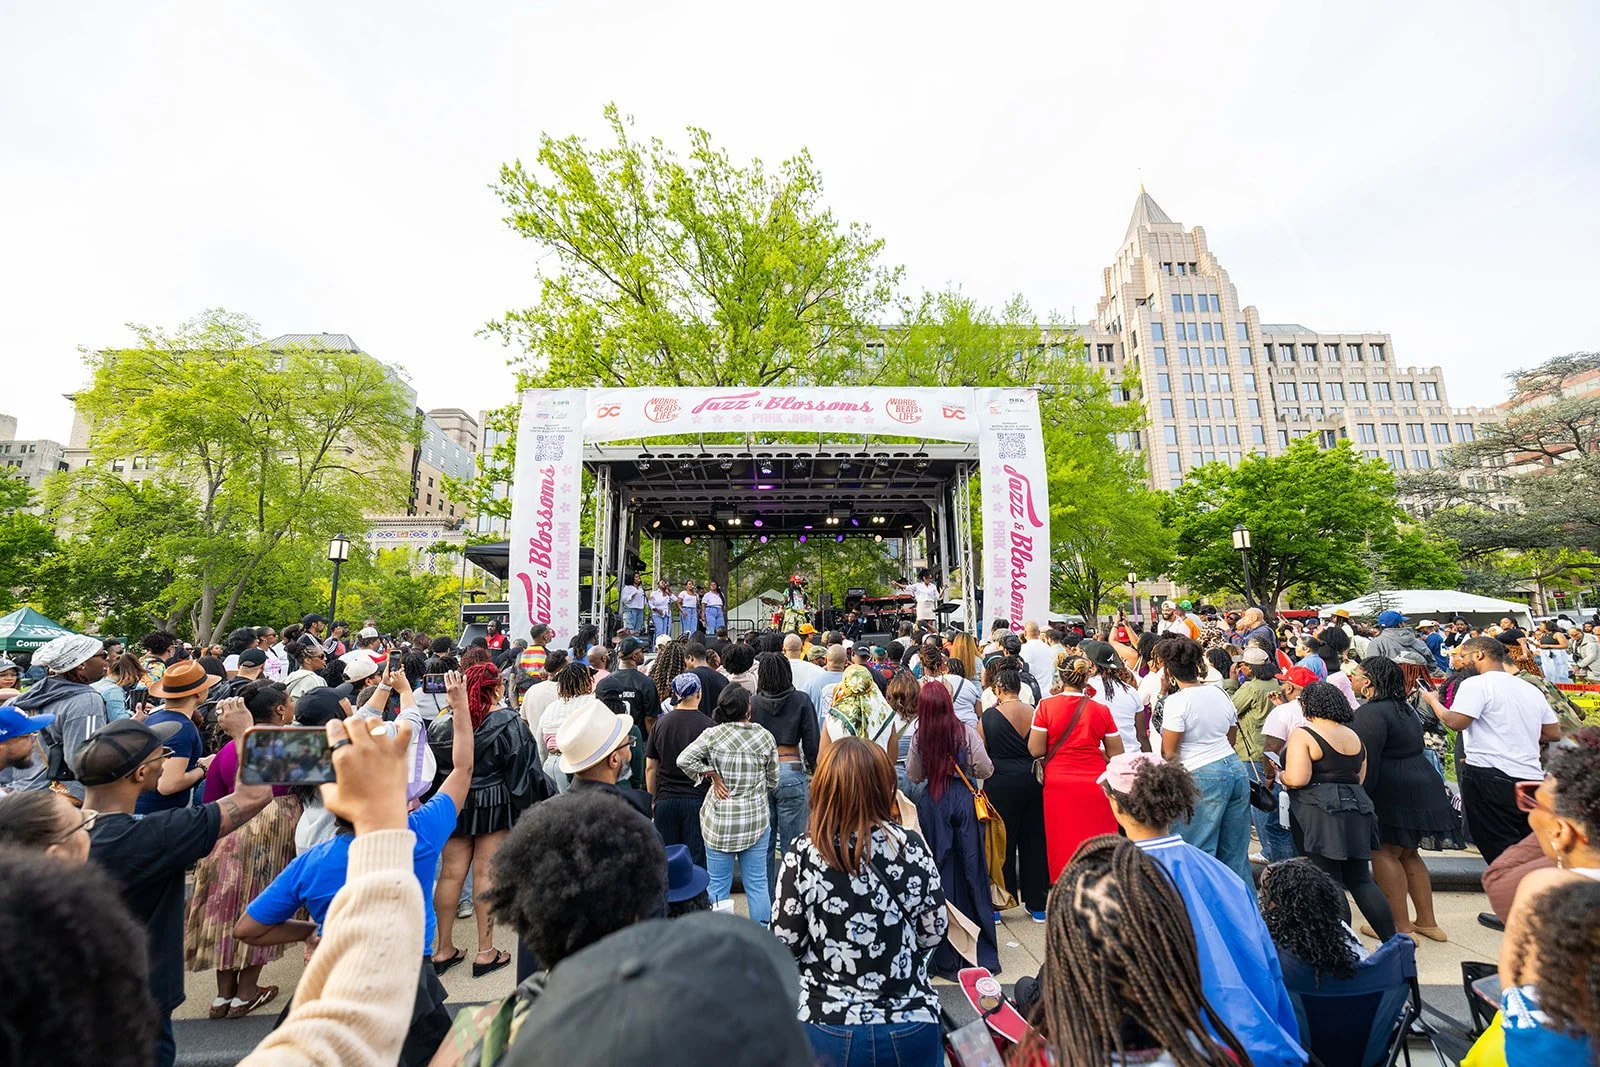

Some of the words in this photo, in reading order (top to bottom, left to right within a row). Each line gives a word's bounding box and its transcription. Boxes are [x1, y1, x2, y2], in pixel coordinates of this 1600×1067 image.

[651, 397, 678, 405] WORDS
[691, 390, 761, 415] Jazz
[754, 400, 763, 408] &
[764, 395, 874, 413] Blossoms
[889, 397, 917, 405] WORDS
[653, 404, 678, 413] BEATS
[895, 405, 918, 413] BEATS
[941, 407, 966, 420] DC
[655, 412, 672, 421] LIFE
[752, 413, 783, 424] PARK
[787, 413, 815, 425] JAM
[898, 412, 914, 421] LIFE
[1003, 464, 1044, 528] Jazz
[529, 464, 556, 570] Blossoms
[1014, 522, 1025, 531] &
[557, 521, 571, 547] JAM
[992, 520, 1006, 550] PARK
[556, 549, 570, 581] PARK
[993, 553, 1007, 579] JAM
[536, 569, 548, 578] &
[1010, 530, 1033, 635] Blossoms
